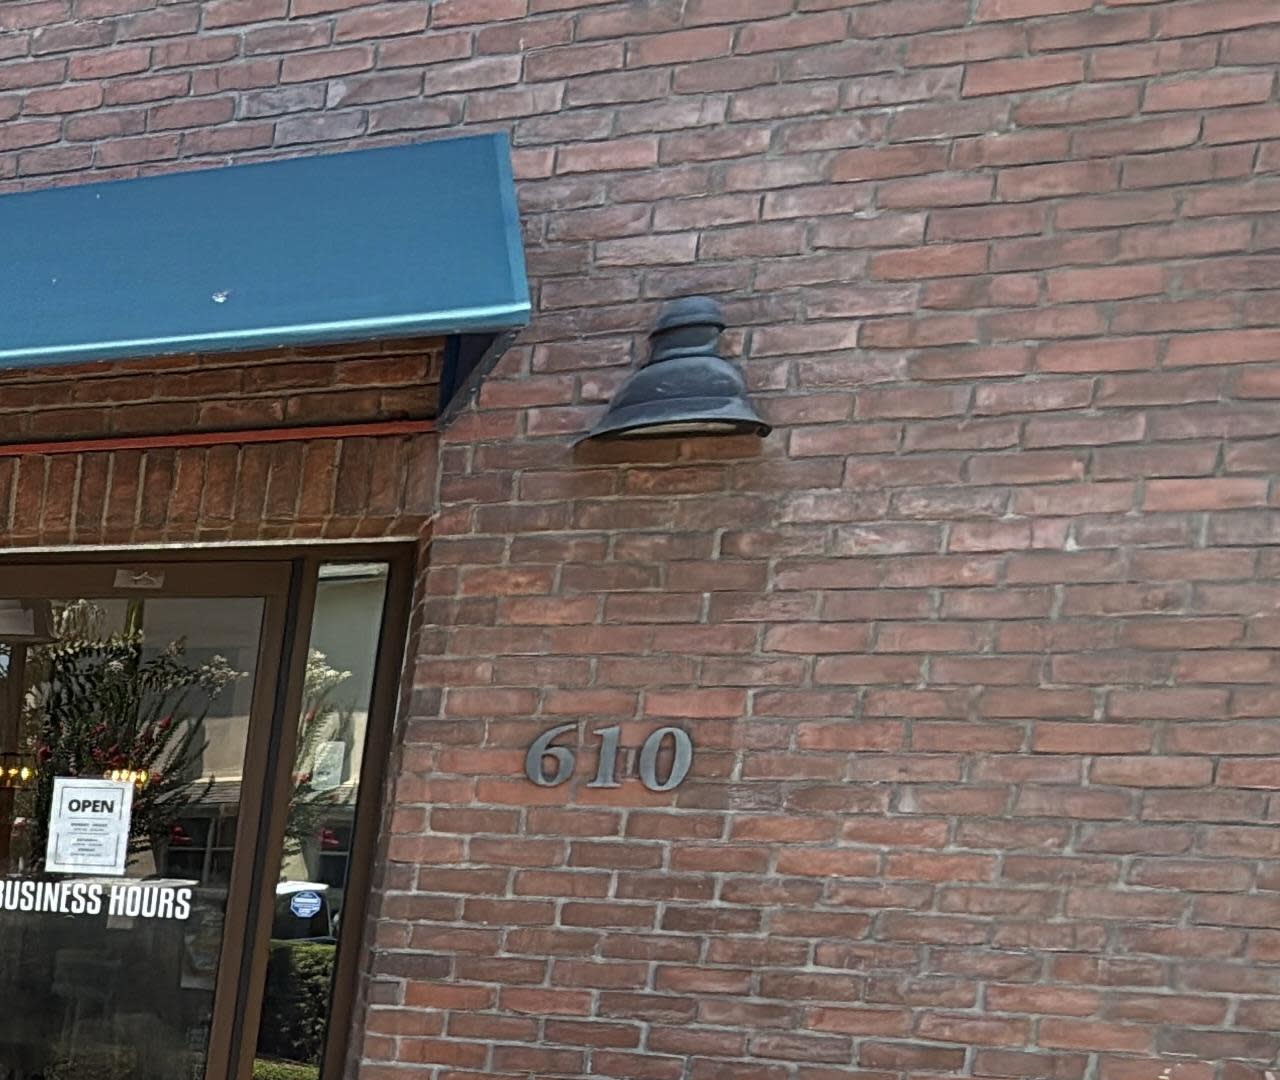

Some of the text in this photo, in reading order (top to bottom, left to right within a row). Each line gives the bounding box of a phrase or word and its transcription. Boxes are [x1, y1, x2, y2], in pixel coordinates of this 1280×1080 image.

[526, 723, 692, 792] 610
[68, 799, 115, 813] OPEN
[107, 885, 192, 920] HOURS
